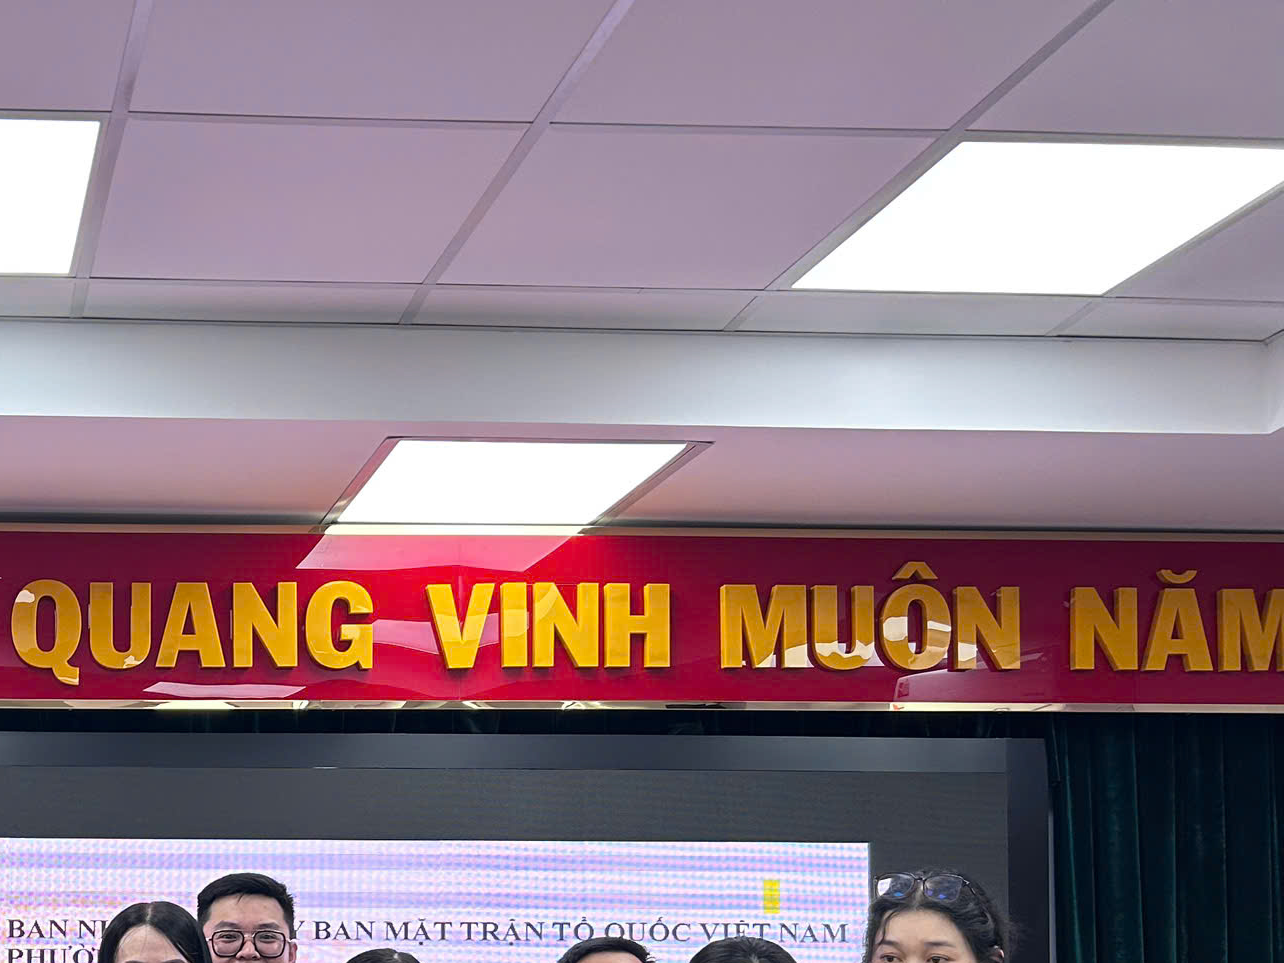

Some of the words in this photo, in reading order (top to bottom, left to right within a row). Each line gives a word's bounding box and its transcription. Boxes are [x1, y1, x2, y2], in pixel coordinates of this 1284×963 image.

[11, 578, 374, 686] QUANG
[425, 582, 672, 670] VINH
[719, 561, 1021, 672] MUÔN
[1070, 569, 1284, 673] NĂM
[6, 919, 69, 939] BAN
[313, 920, 376, 941] BAN
[385, 918, 453, 946] MẶT
[460, 918, 546, 946] TRẬN
[551, 917, 595, 942] TỔ
[603, 917, 692, 943] QUỐC
[778, 923, 849, 944] NAM
